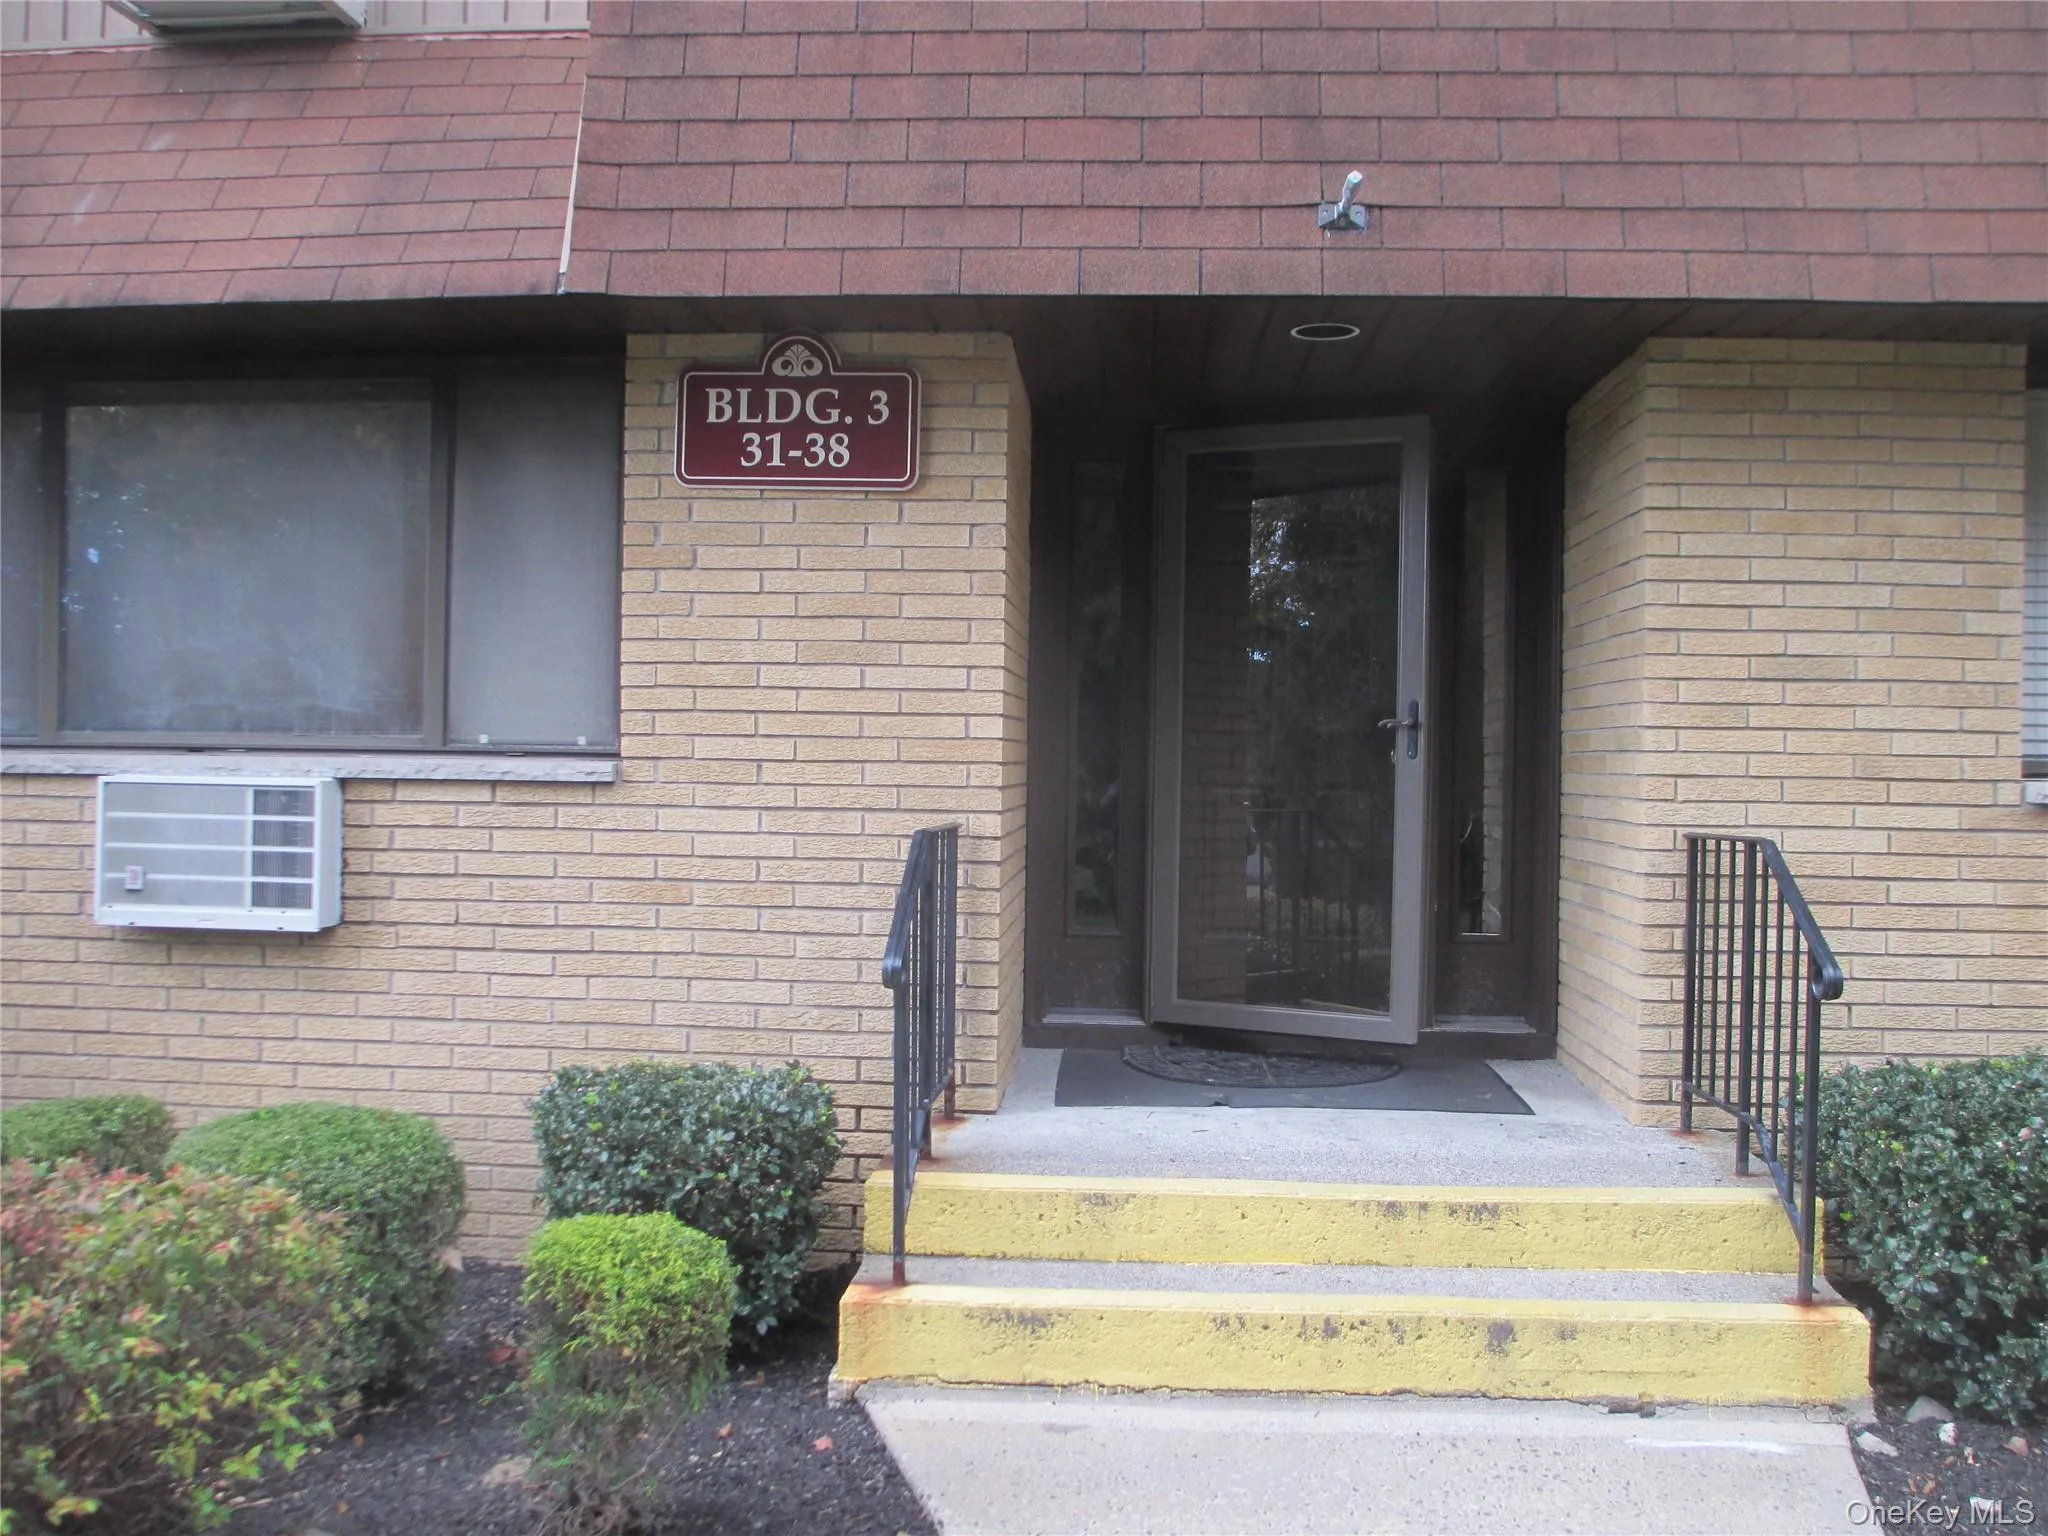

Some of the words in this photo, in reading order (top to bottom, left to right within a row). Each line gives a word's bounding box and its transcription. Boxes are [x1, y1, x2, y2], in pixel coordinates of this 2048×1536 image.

[705, 387, 853, 425] BLDG.
[867, 389, 890, 425] 3
[740, 432, 850, 468] 31-38
